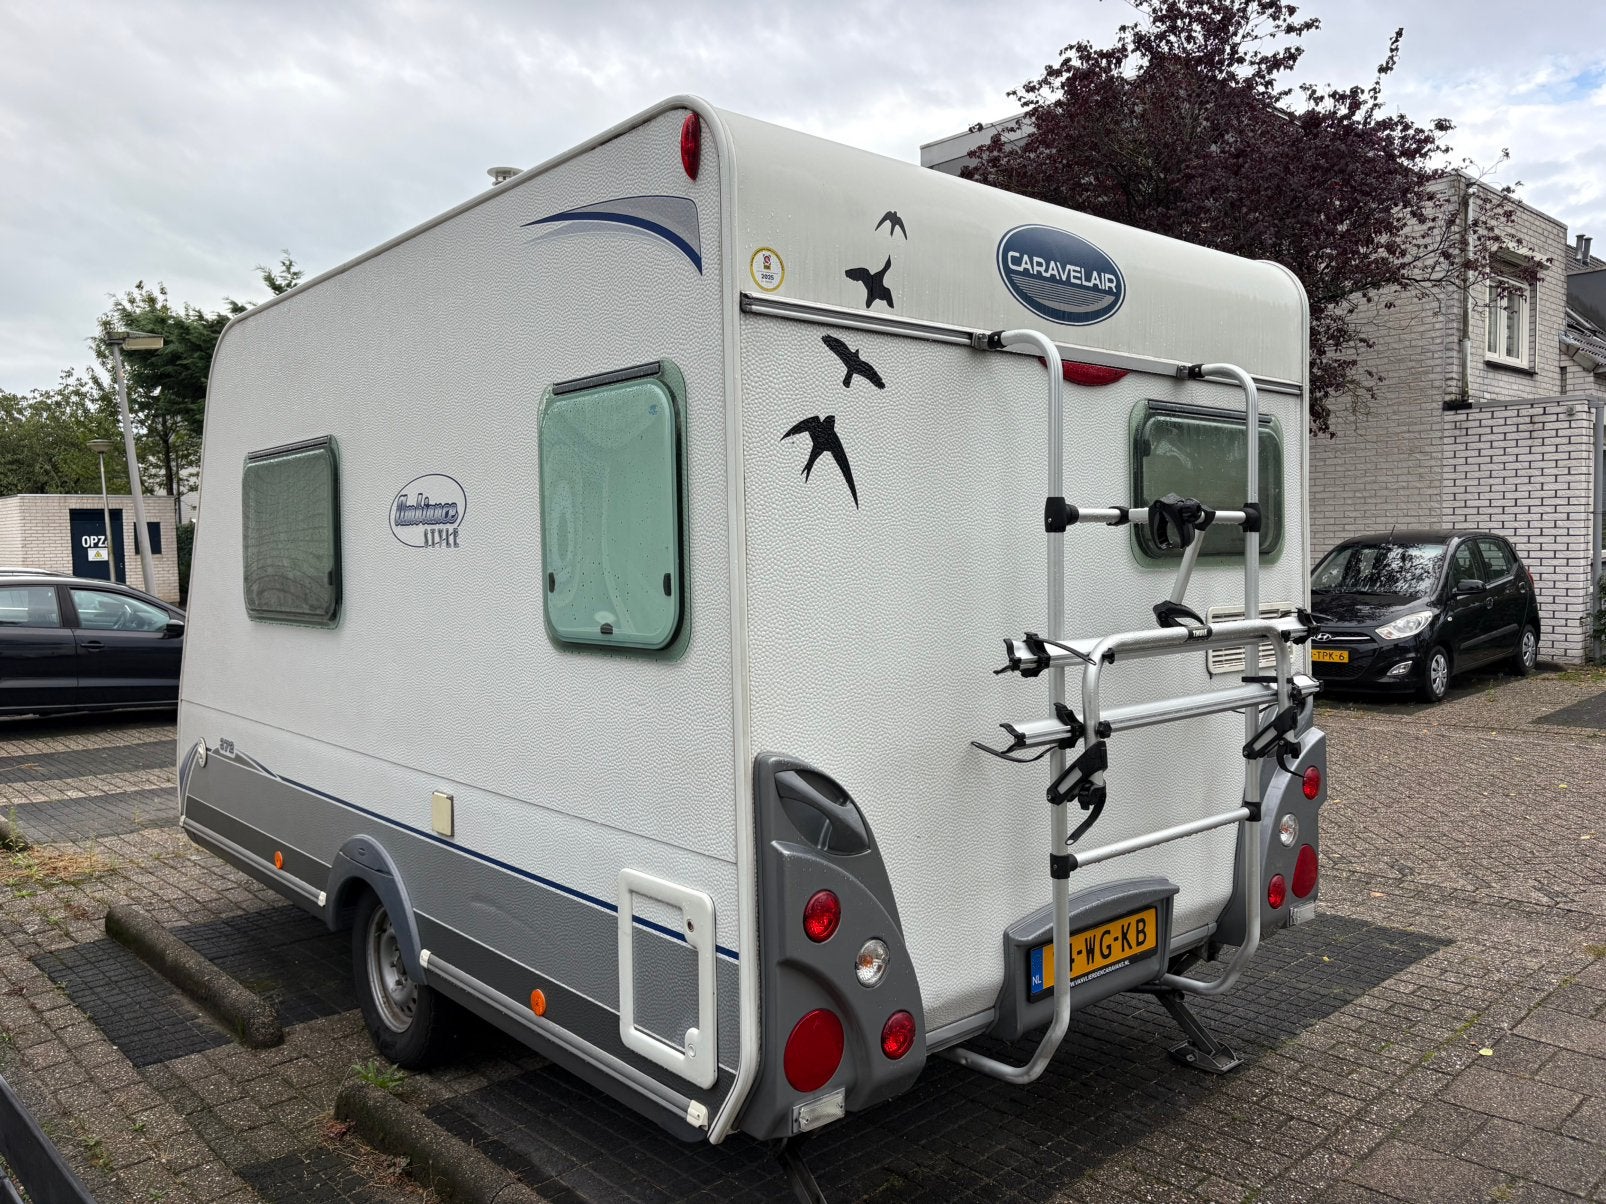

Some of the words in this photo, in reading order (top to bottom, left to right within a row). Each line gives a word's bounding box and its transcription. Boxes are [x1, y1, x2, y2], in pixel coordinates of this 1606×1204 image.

[760, 273, 775, 281] 2025
[1007, 250, 1117, 293] CARAVELAIR
[424, 527, 460, 548] STYLE
[1311, 651, 1345, 661] -TPK-6
[1053, 917, 1147, 973] 4-WG-KB
[1032, 974, 1042, 986] NL
